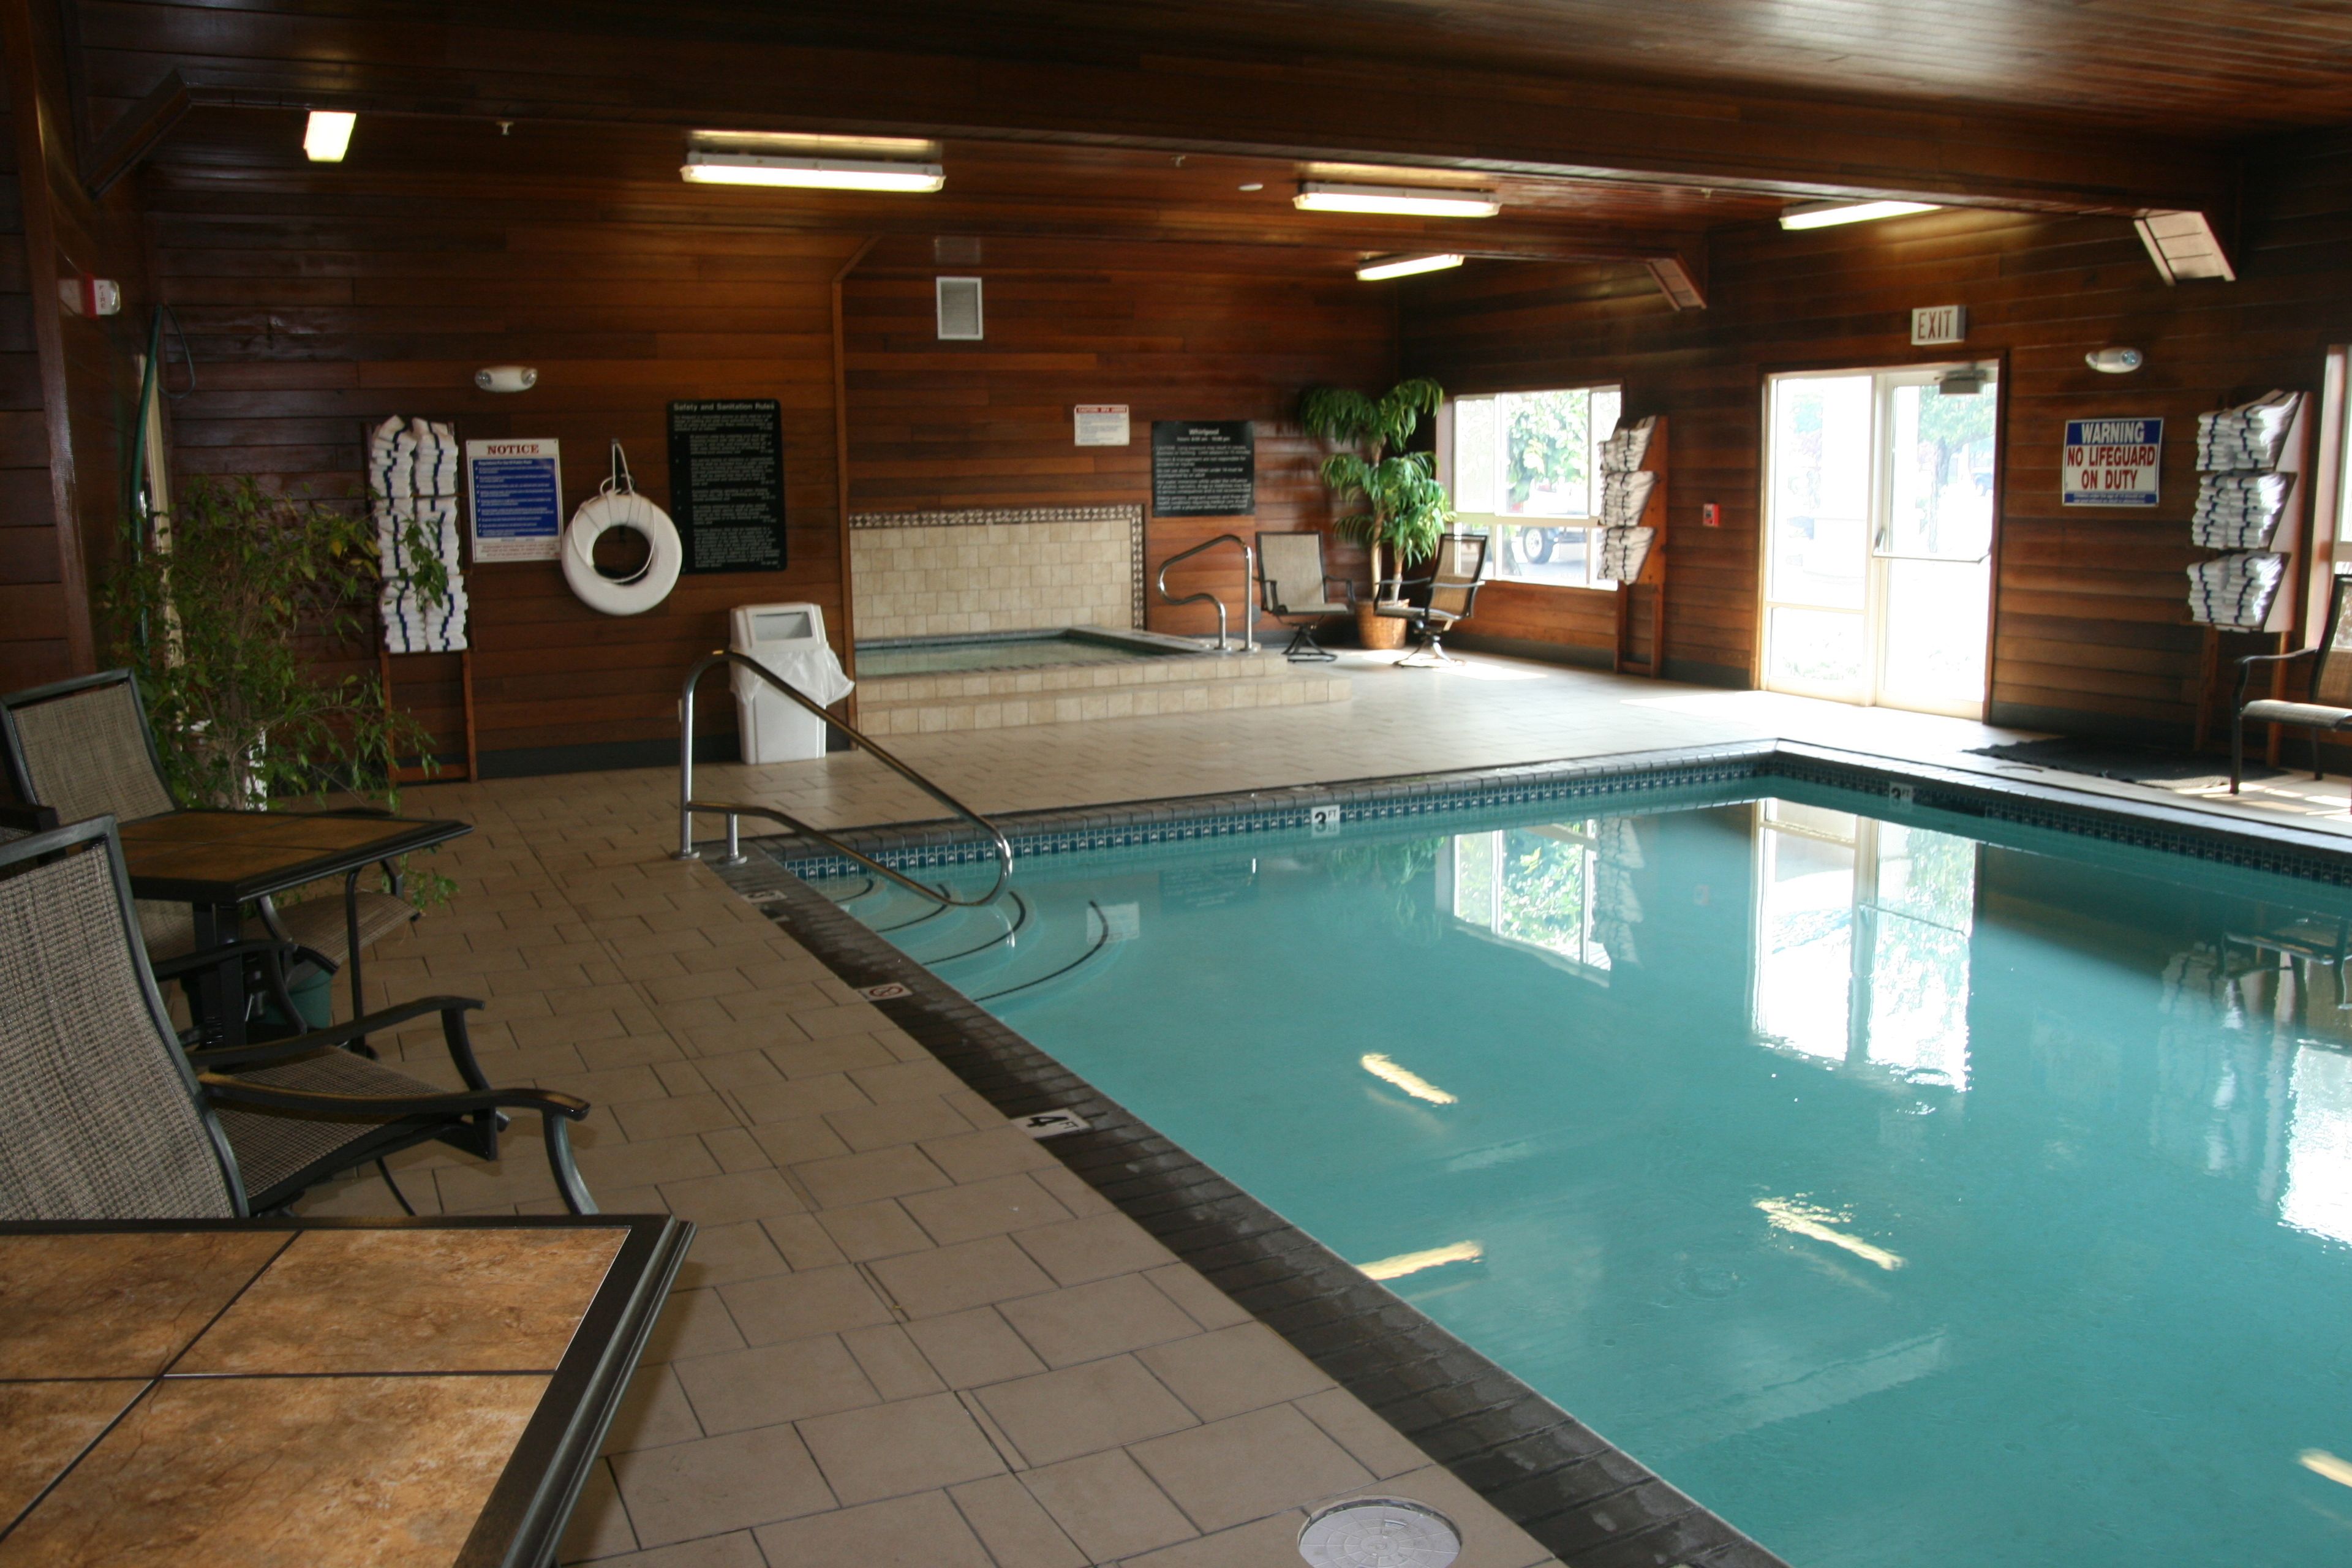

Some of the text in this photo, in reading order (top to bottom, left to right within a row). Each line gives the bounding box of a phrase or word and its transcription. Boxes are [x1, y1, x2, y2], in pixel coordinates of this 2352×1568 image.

[1918, 310, 1952, 339] EXIT
[674, 402, 698, 411] Safety
[755, 401, 775, 410] Rules
[2081, 422, 2145, 444] WARNING
[487, 444, 539, 455] NOTICE
[2067, 447, 2155, 466] NO LIFEGUARD
[2081, 469, 2138, 489] ON DUTY
[1328, 809, 1336, 818] FT
[1027, 1116, 1069, 1128] 4
